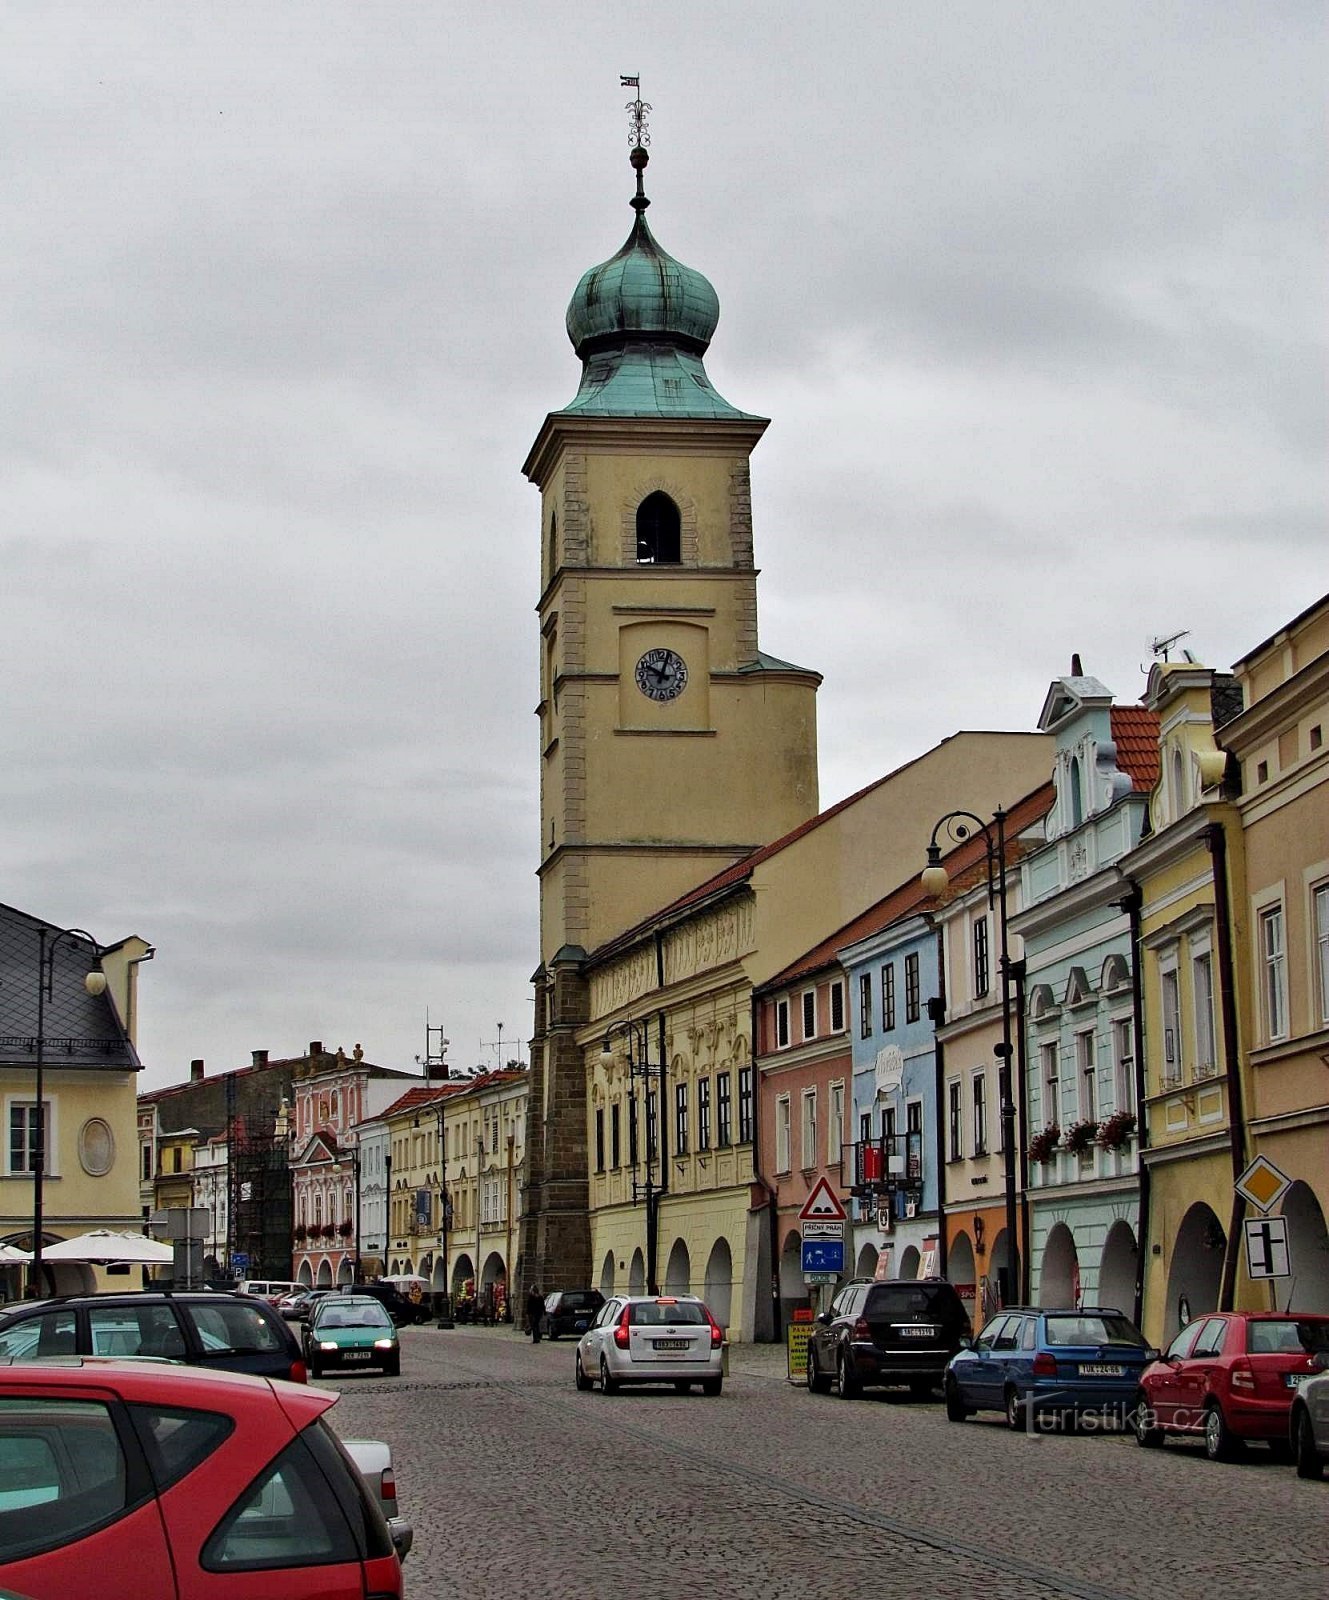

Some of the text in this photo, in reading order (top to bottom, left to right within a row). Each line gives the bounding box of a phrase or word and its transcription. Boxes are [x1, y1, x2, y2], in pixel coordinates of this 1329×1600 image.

[675, 661, 682, 670] 2
[638, 671, 645, 680] 9
[679, 671, 685, 681] 3
[659, 691, 666, 699] 6
[669, 689, 676, 698] 5
[235, 1267, 242, 1276] P
